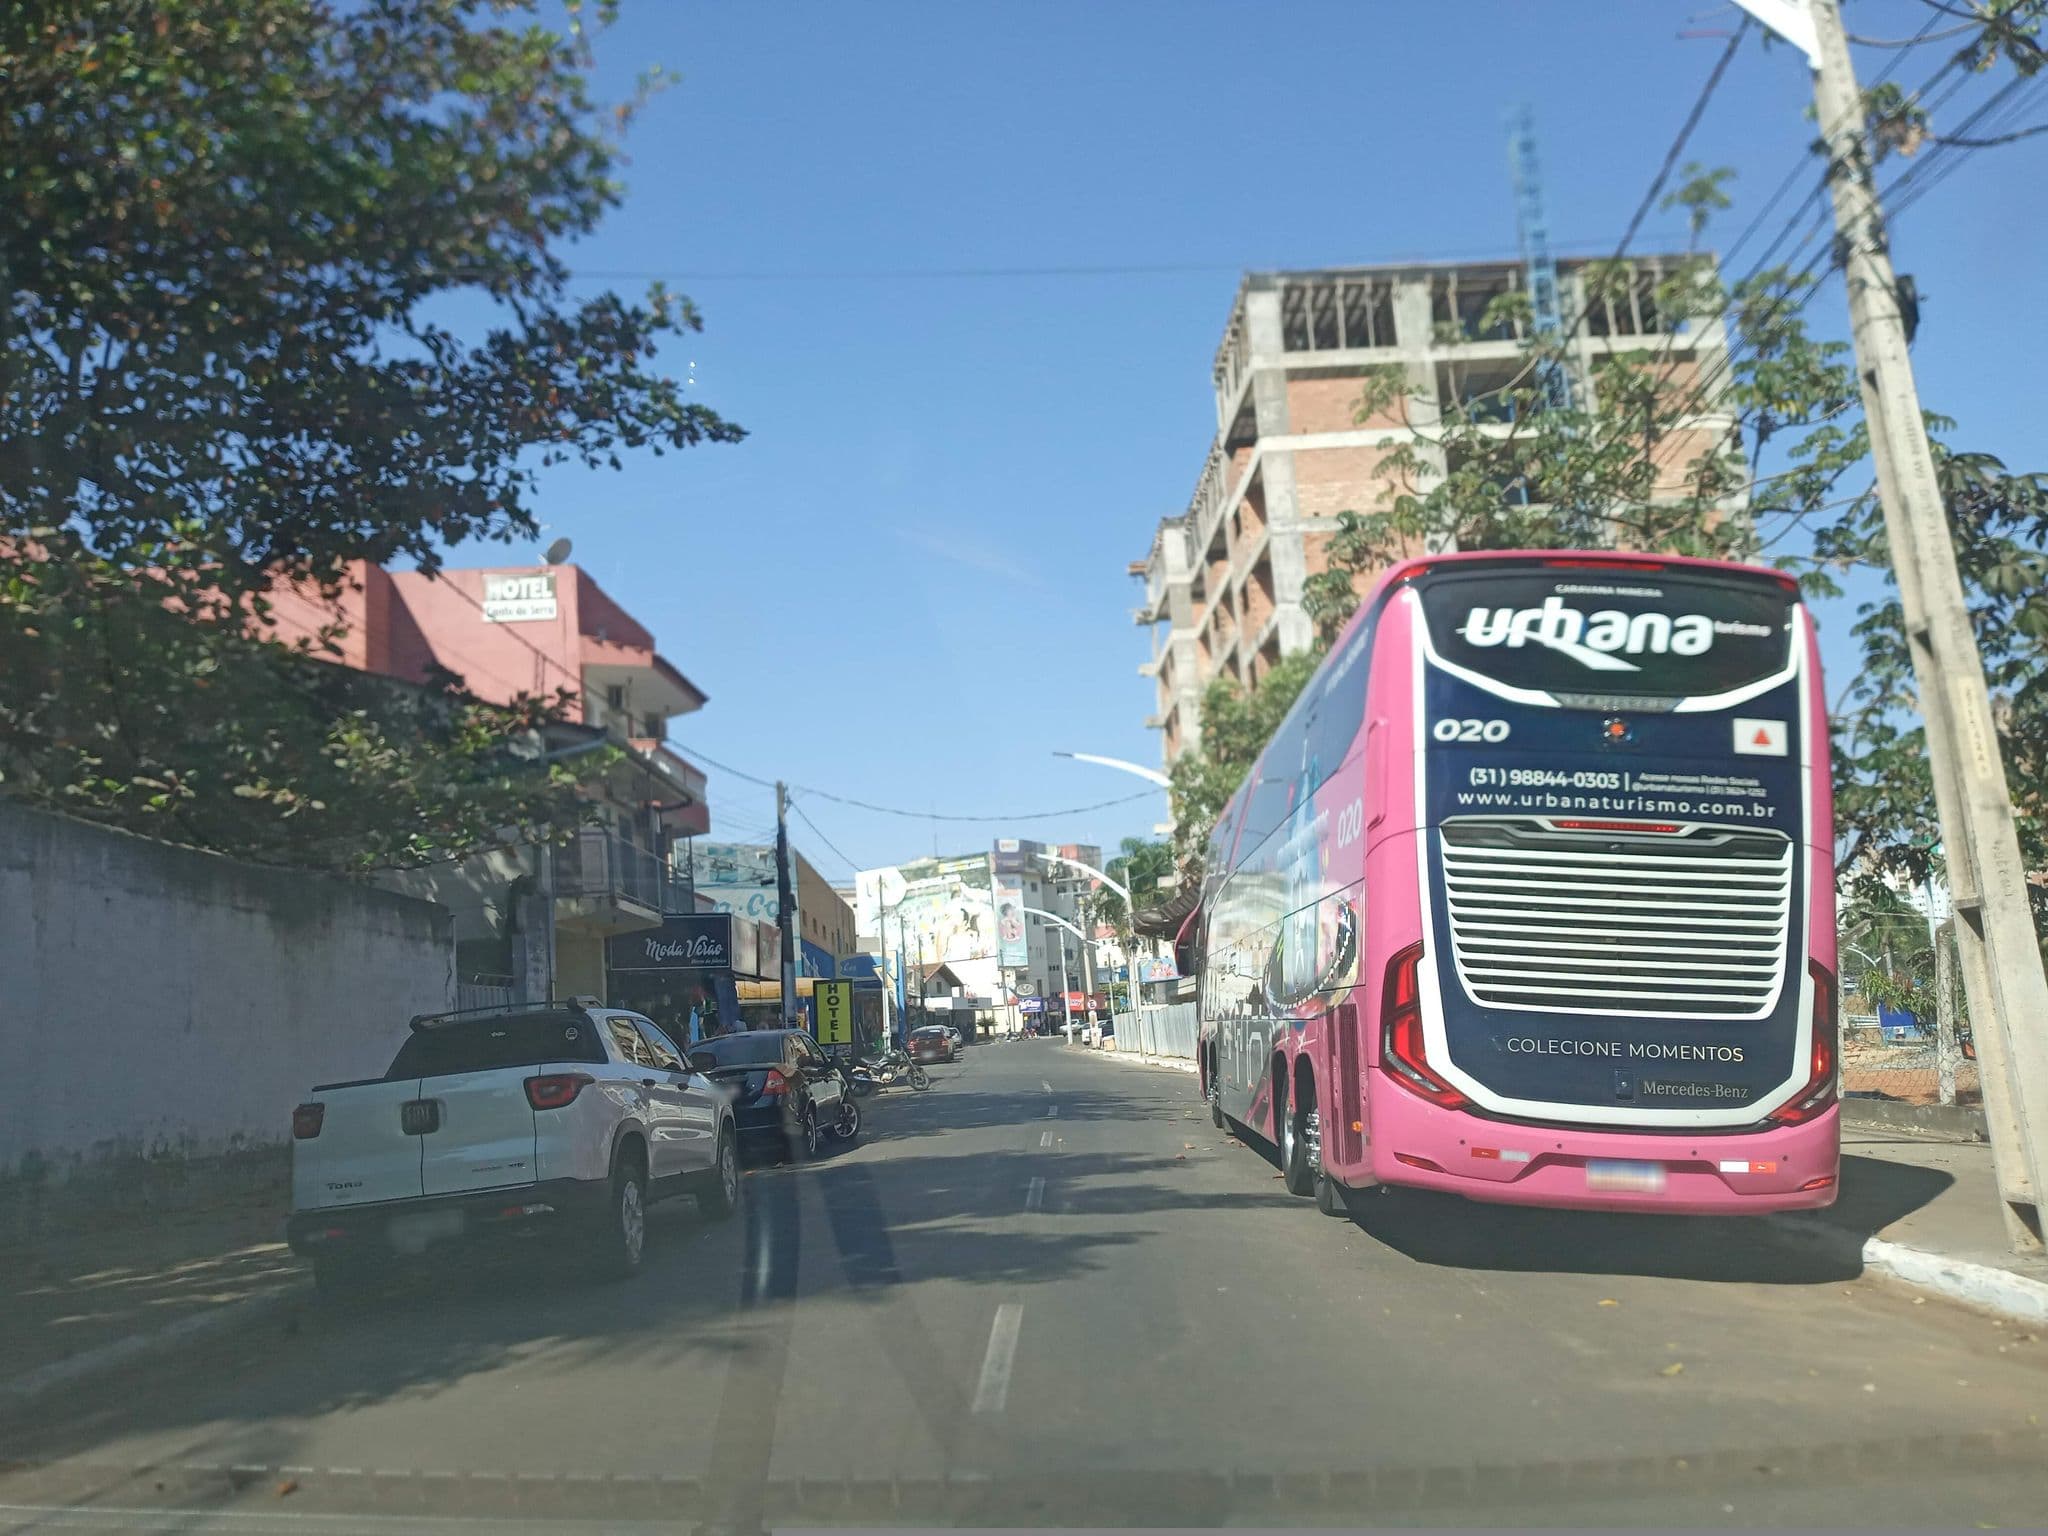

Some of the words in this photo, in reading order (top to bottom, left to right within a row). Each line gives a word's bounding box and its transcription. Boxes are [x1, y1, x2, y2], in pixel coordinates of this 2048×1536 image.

[486, 577, 554, 600] HOTEL
[1458, 596, 1714, 664] urbana
[1714, 620, 1772, 638] turismo
[1433, 718, 1511, 743] 020
[1470, 767, 1506, 787] (31)
[1510, 769, 1620, 789] 98844-0303
[1458, 791, 1776, 818] www.urbanaturismo.com.br
[1337, 796, 1362, 849] 020
[645, 937, 685, 962] Moda
[686, 935, 723, 958] Verão
[827, 982, 840, 1042] HOTEL
[1507, 1037, 1623, 1058] COLECIONE
[1628, 1042, 1745, 1062] MOMENTOS
[1642, 1080, 1750, 1099] Mercedes-Benz
